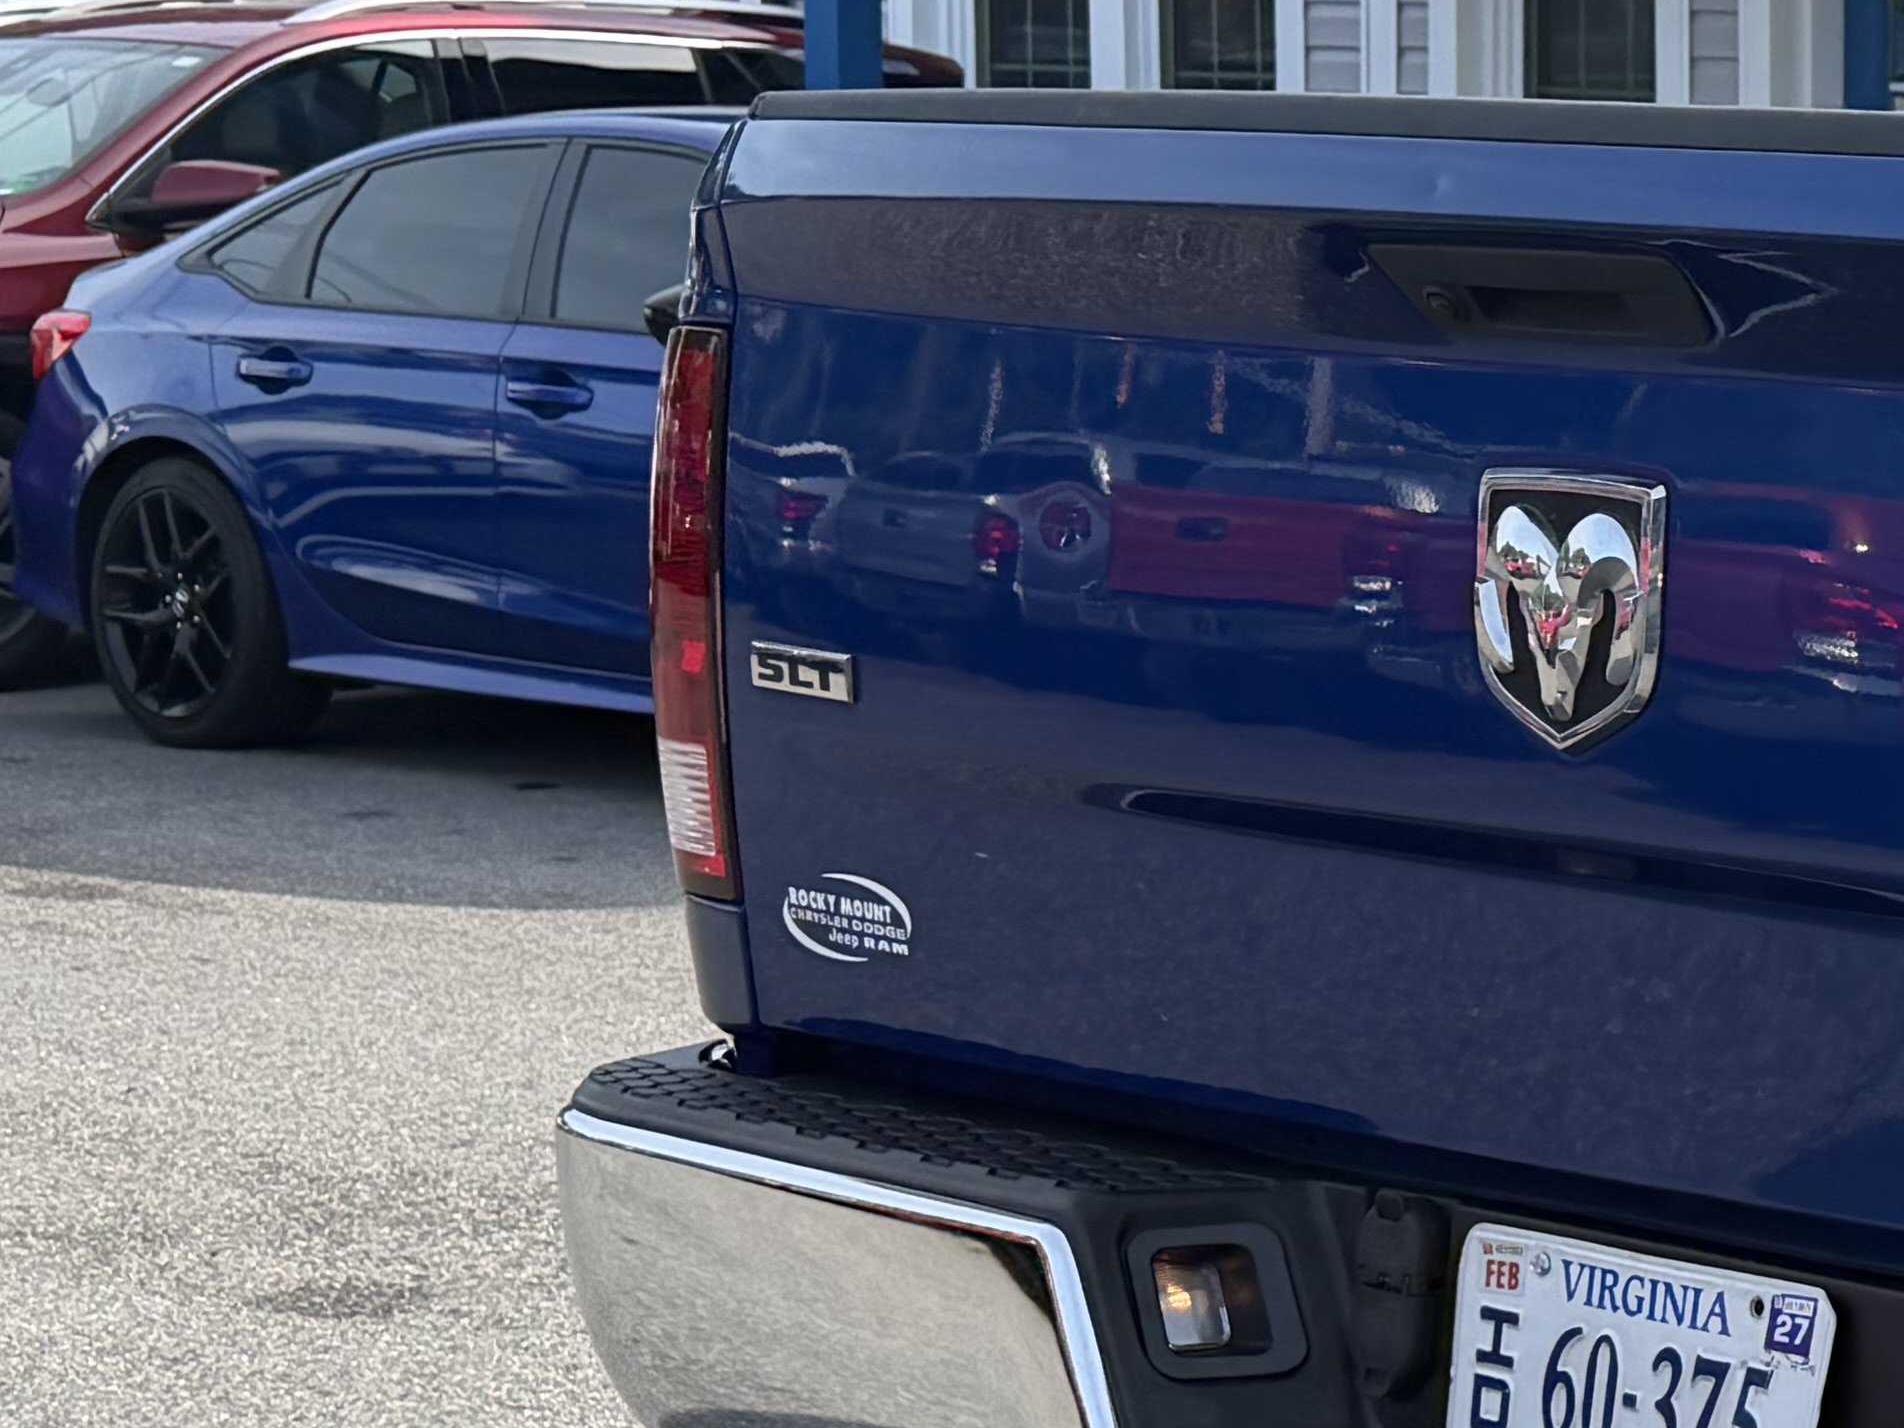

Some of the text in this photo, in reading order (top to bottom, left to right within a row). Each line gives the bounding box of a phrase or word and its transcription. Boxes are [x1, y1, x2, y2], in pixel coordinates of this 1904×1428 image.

[757, 652, 845, 693] SLT
[787, 886, 892, 924] ROCKY MOUNT
[790, 906, 908, 941] CHRYSLER DODGE
[828, 927, 910, 956] Jeep RAM
[1485, 1258, 1520, 1290] FEB
[1561, 1258, 1732, 1338] VIRGINIA
[1773, 1314, 1811, 1345] 27
